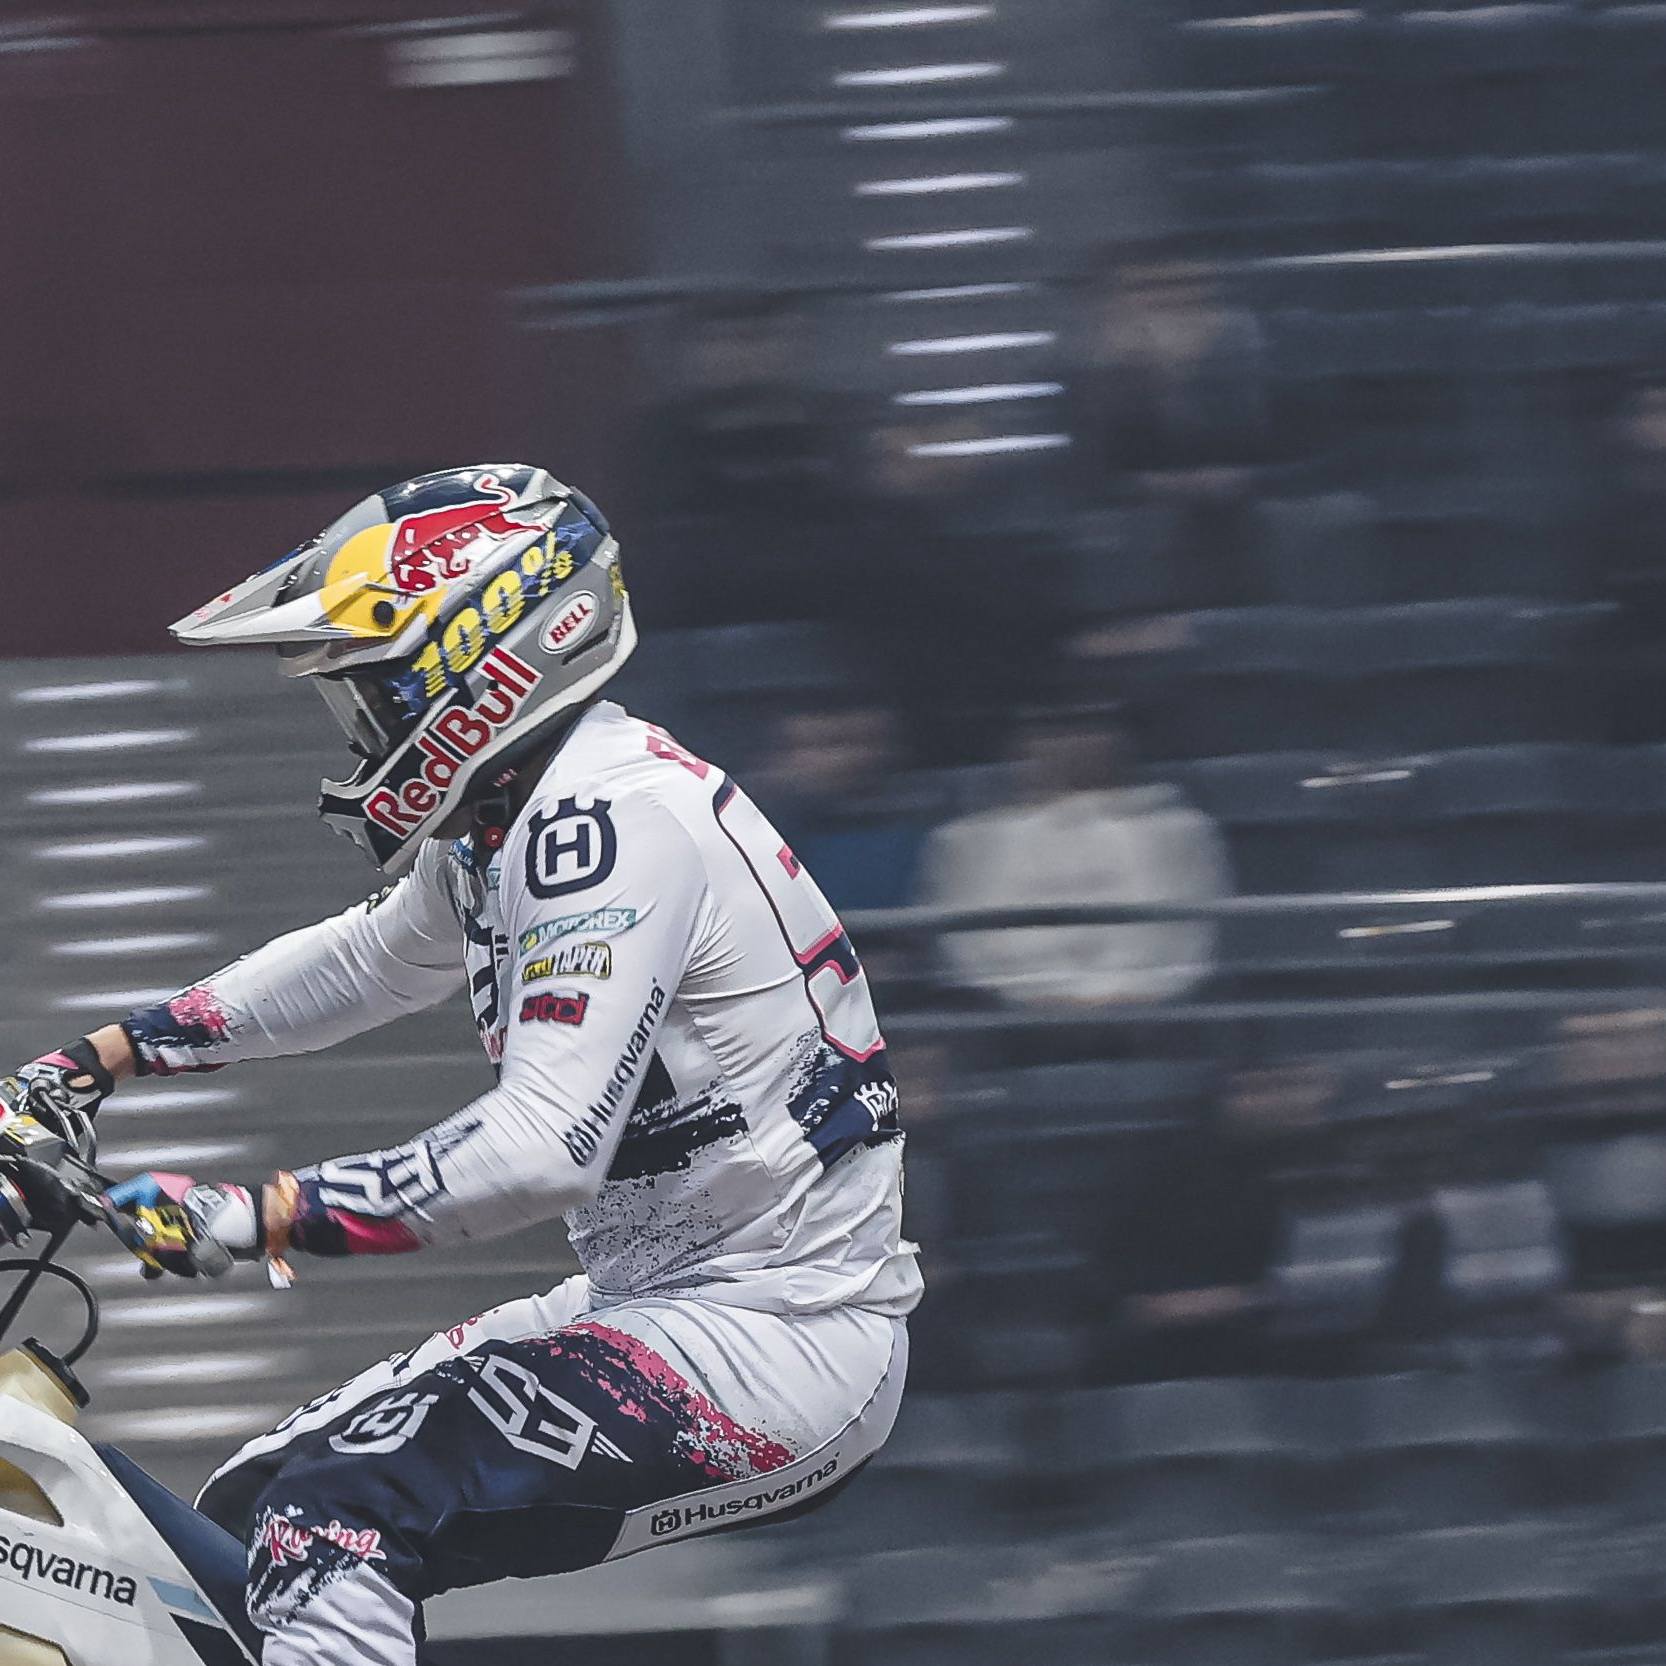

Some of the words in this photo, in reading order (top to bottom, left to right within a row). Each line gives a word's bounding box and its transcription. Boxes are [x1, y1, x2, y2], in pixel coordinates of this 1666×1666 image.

[410, 530, 575, 698] 100%
[549, 603, 593, 644] BELL
[684, 1456, 839, 1527] Husqvarna
